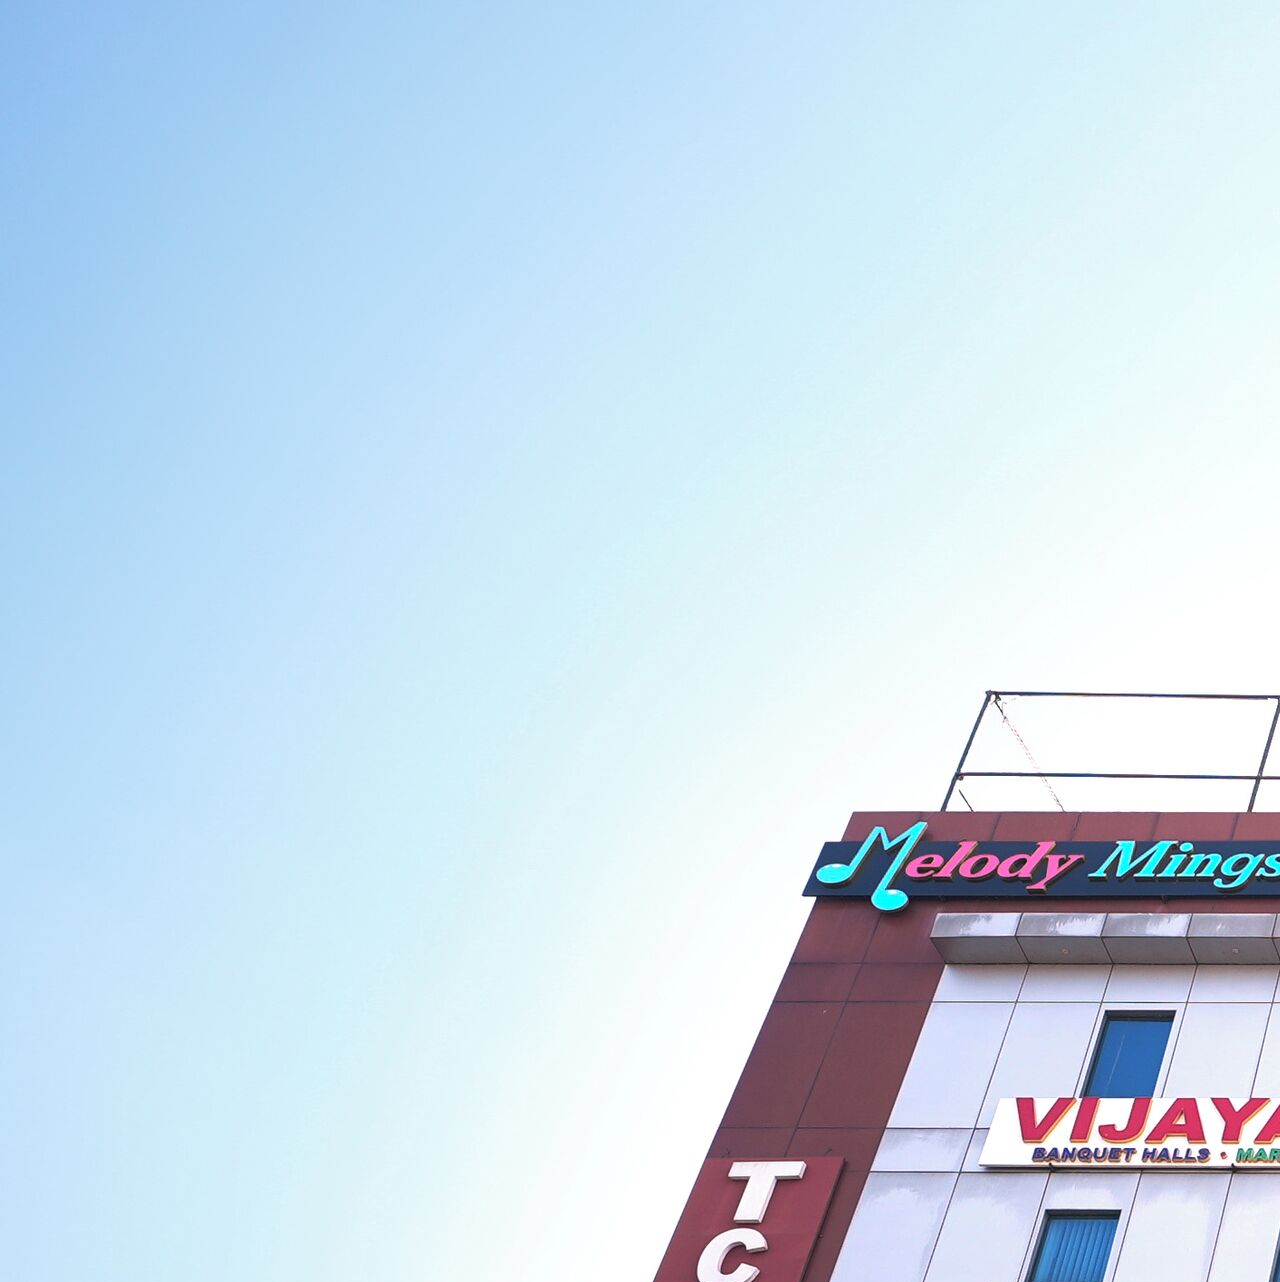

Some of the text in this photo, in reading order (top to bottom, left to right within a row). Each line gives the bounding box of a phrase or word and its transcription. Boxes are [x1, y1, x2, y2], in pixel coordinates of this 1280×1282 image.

[816, 821, 1084, 911] Melody
[1032, 1147, 1137, 1163] BANQUET
[1142, 1147, 1212, 1163] HALLS
